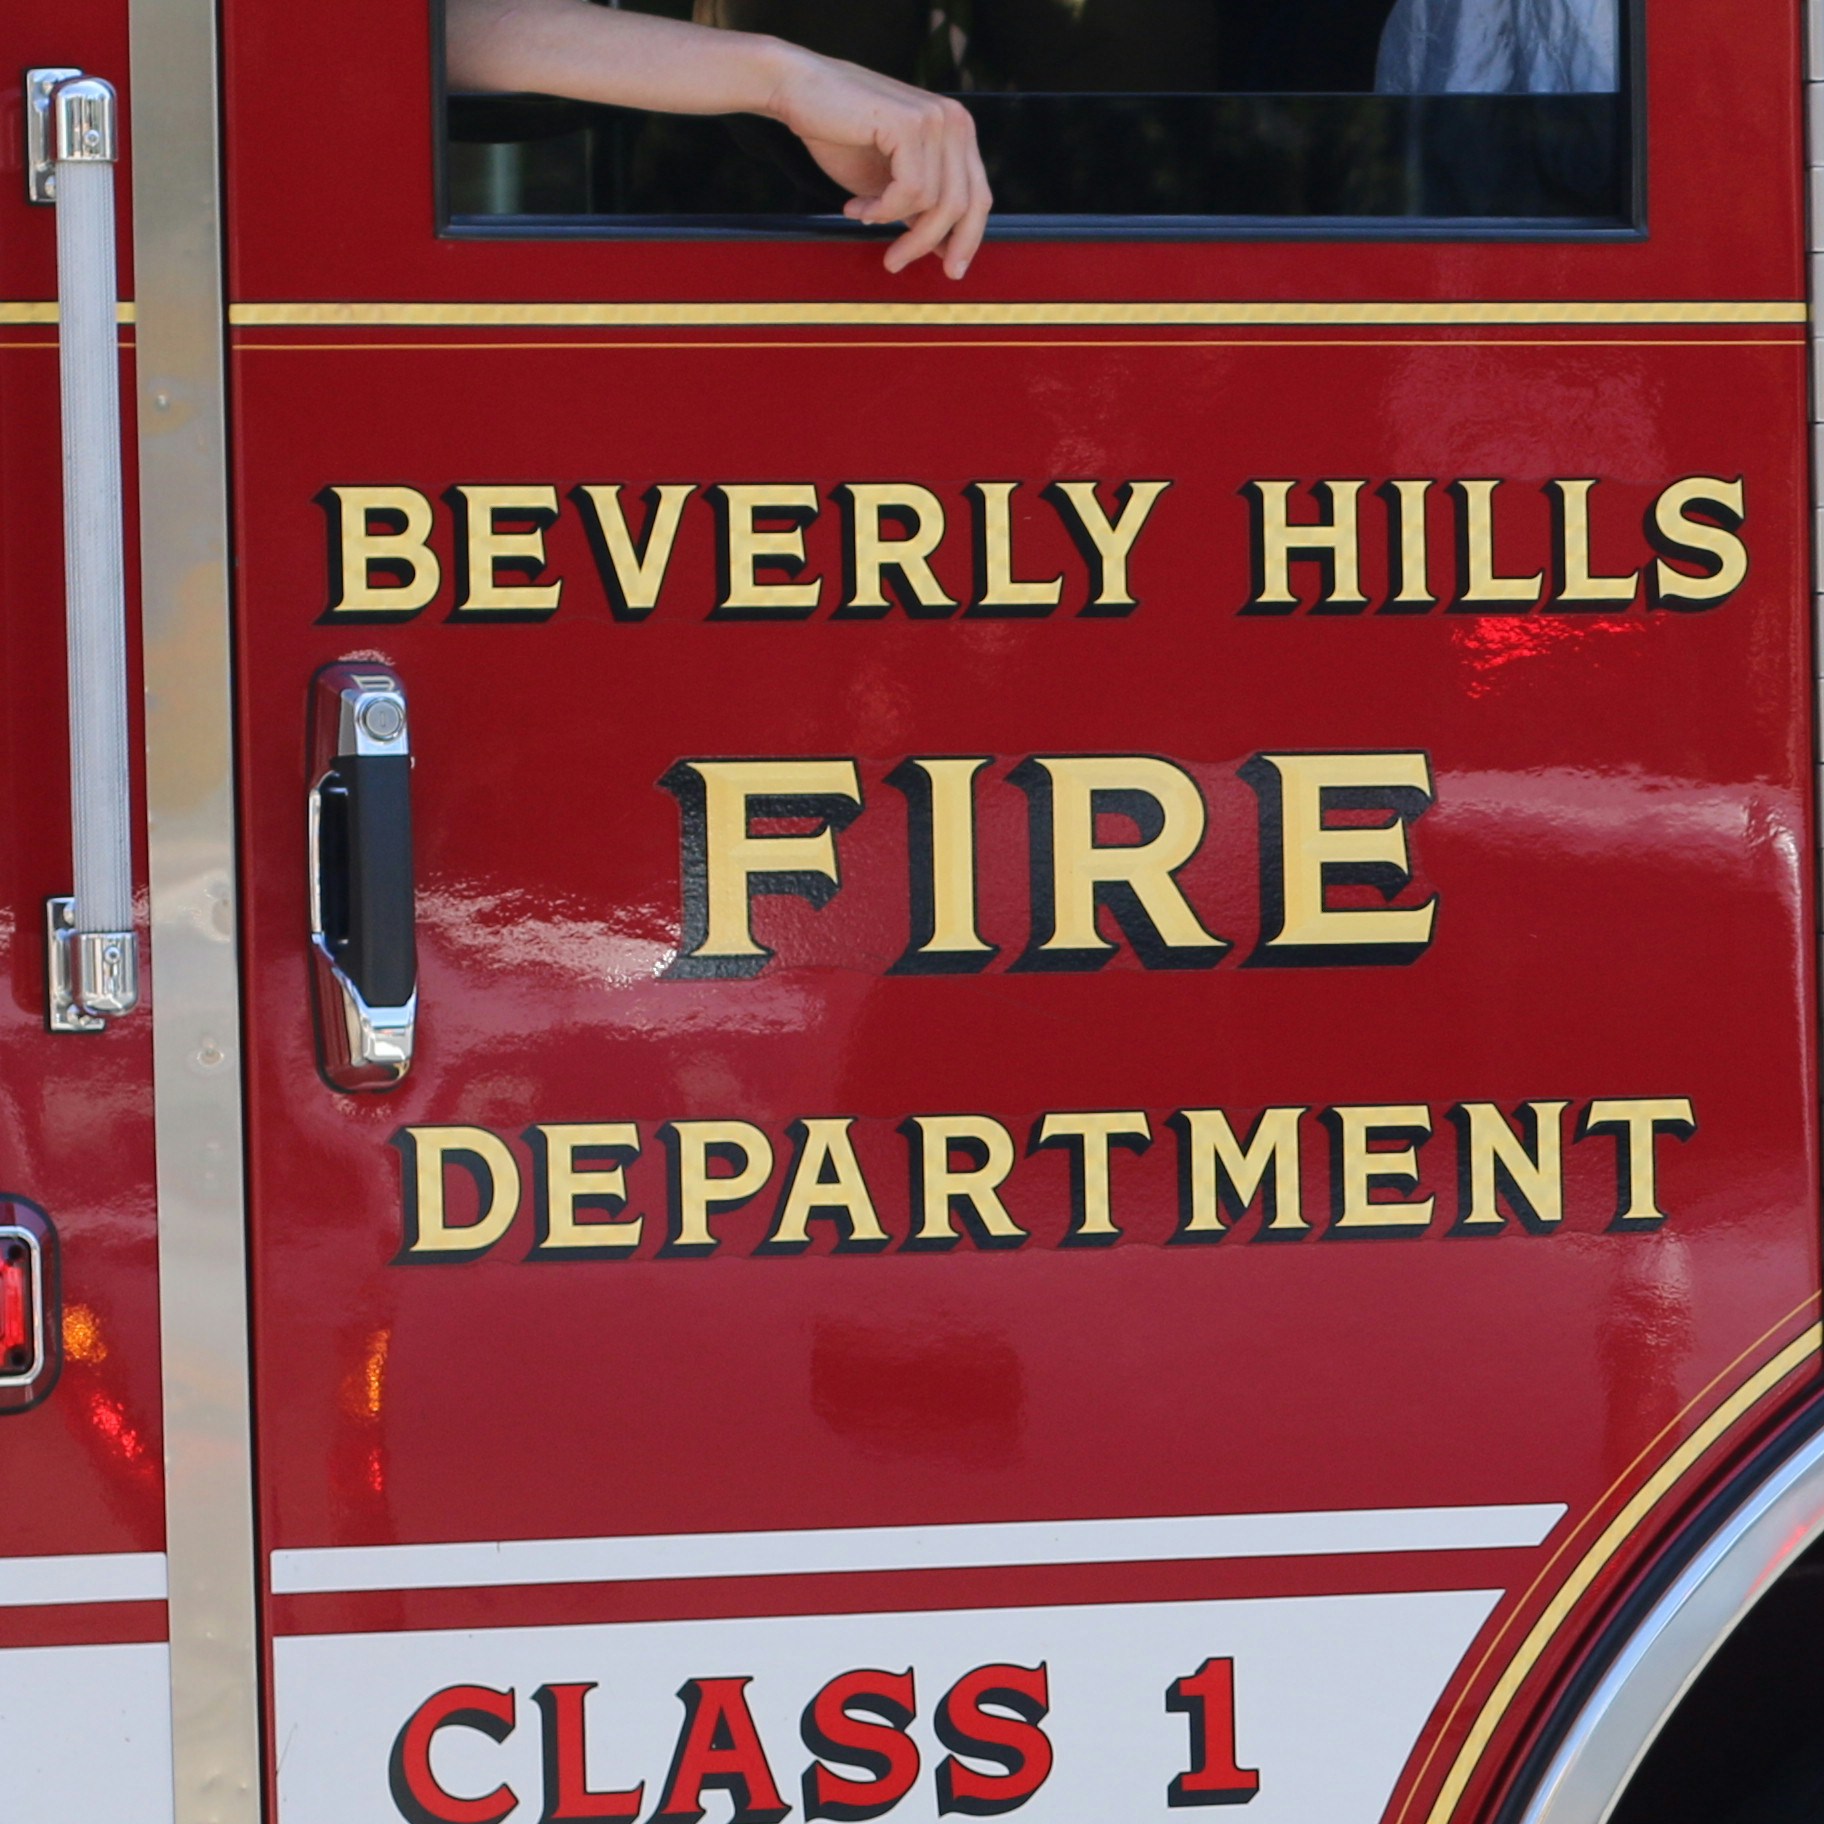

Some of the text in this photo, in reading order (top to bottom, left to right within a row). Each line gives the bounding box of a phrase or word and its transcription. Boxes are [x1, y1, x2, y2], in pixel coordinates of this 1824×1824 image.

[315, 474, 1749, 626] BEVERLY HILLS
[658, 749, 1439, 981] FIRE
[391, 1097, 1696, 1266] DEPARTMENT
[1165, 1656, 1260, 1808] 1
